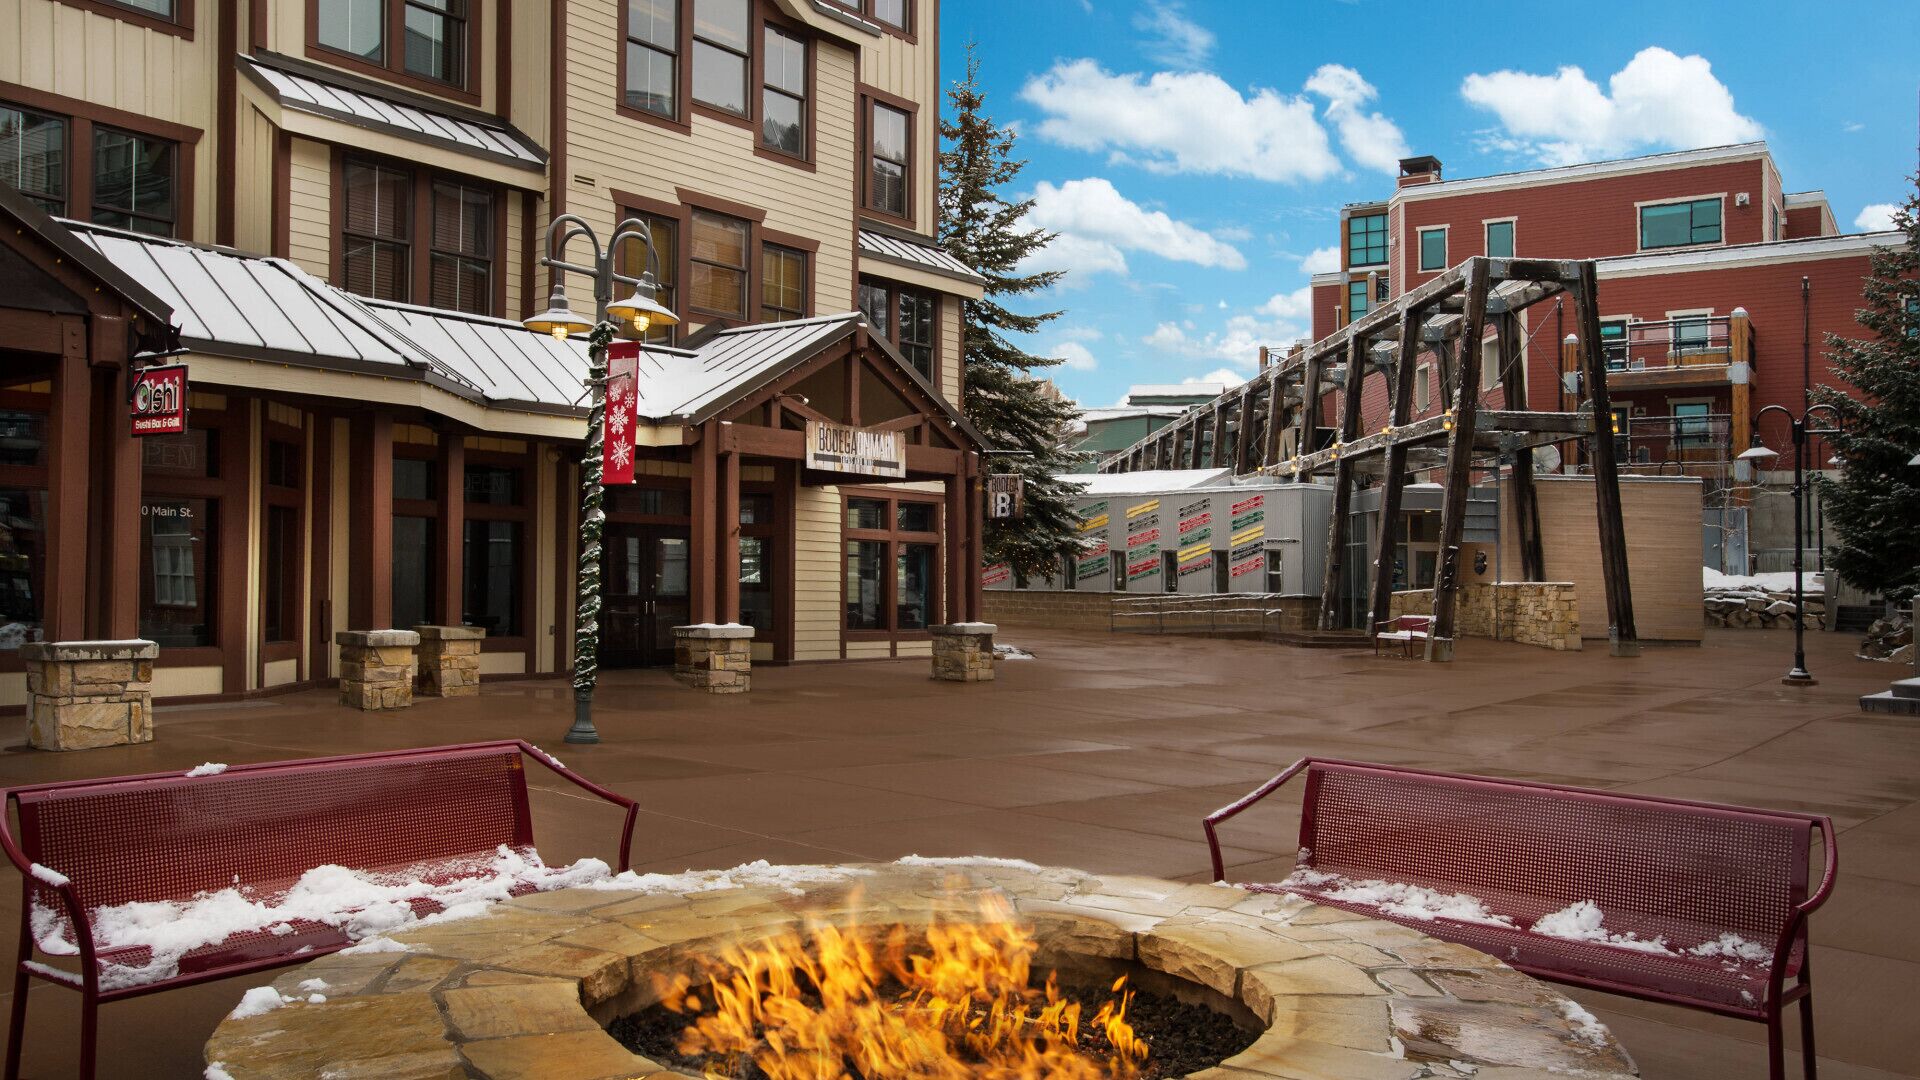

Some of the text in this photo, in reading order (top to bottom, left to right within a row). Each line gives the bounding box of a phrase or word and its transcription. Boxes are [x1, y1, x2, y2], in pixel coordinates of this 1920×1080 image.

[137, 376, 180, 413] Oishi
[135, 417, 180, 430] Sushi Bar & Grill
[151, 506, 177, 517] Main
[179, 507, 194, 518] St.
